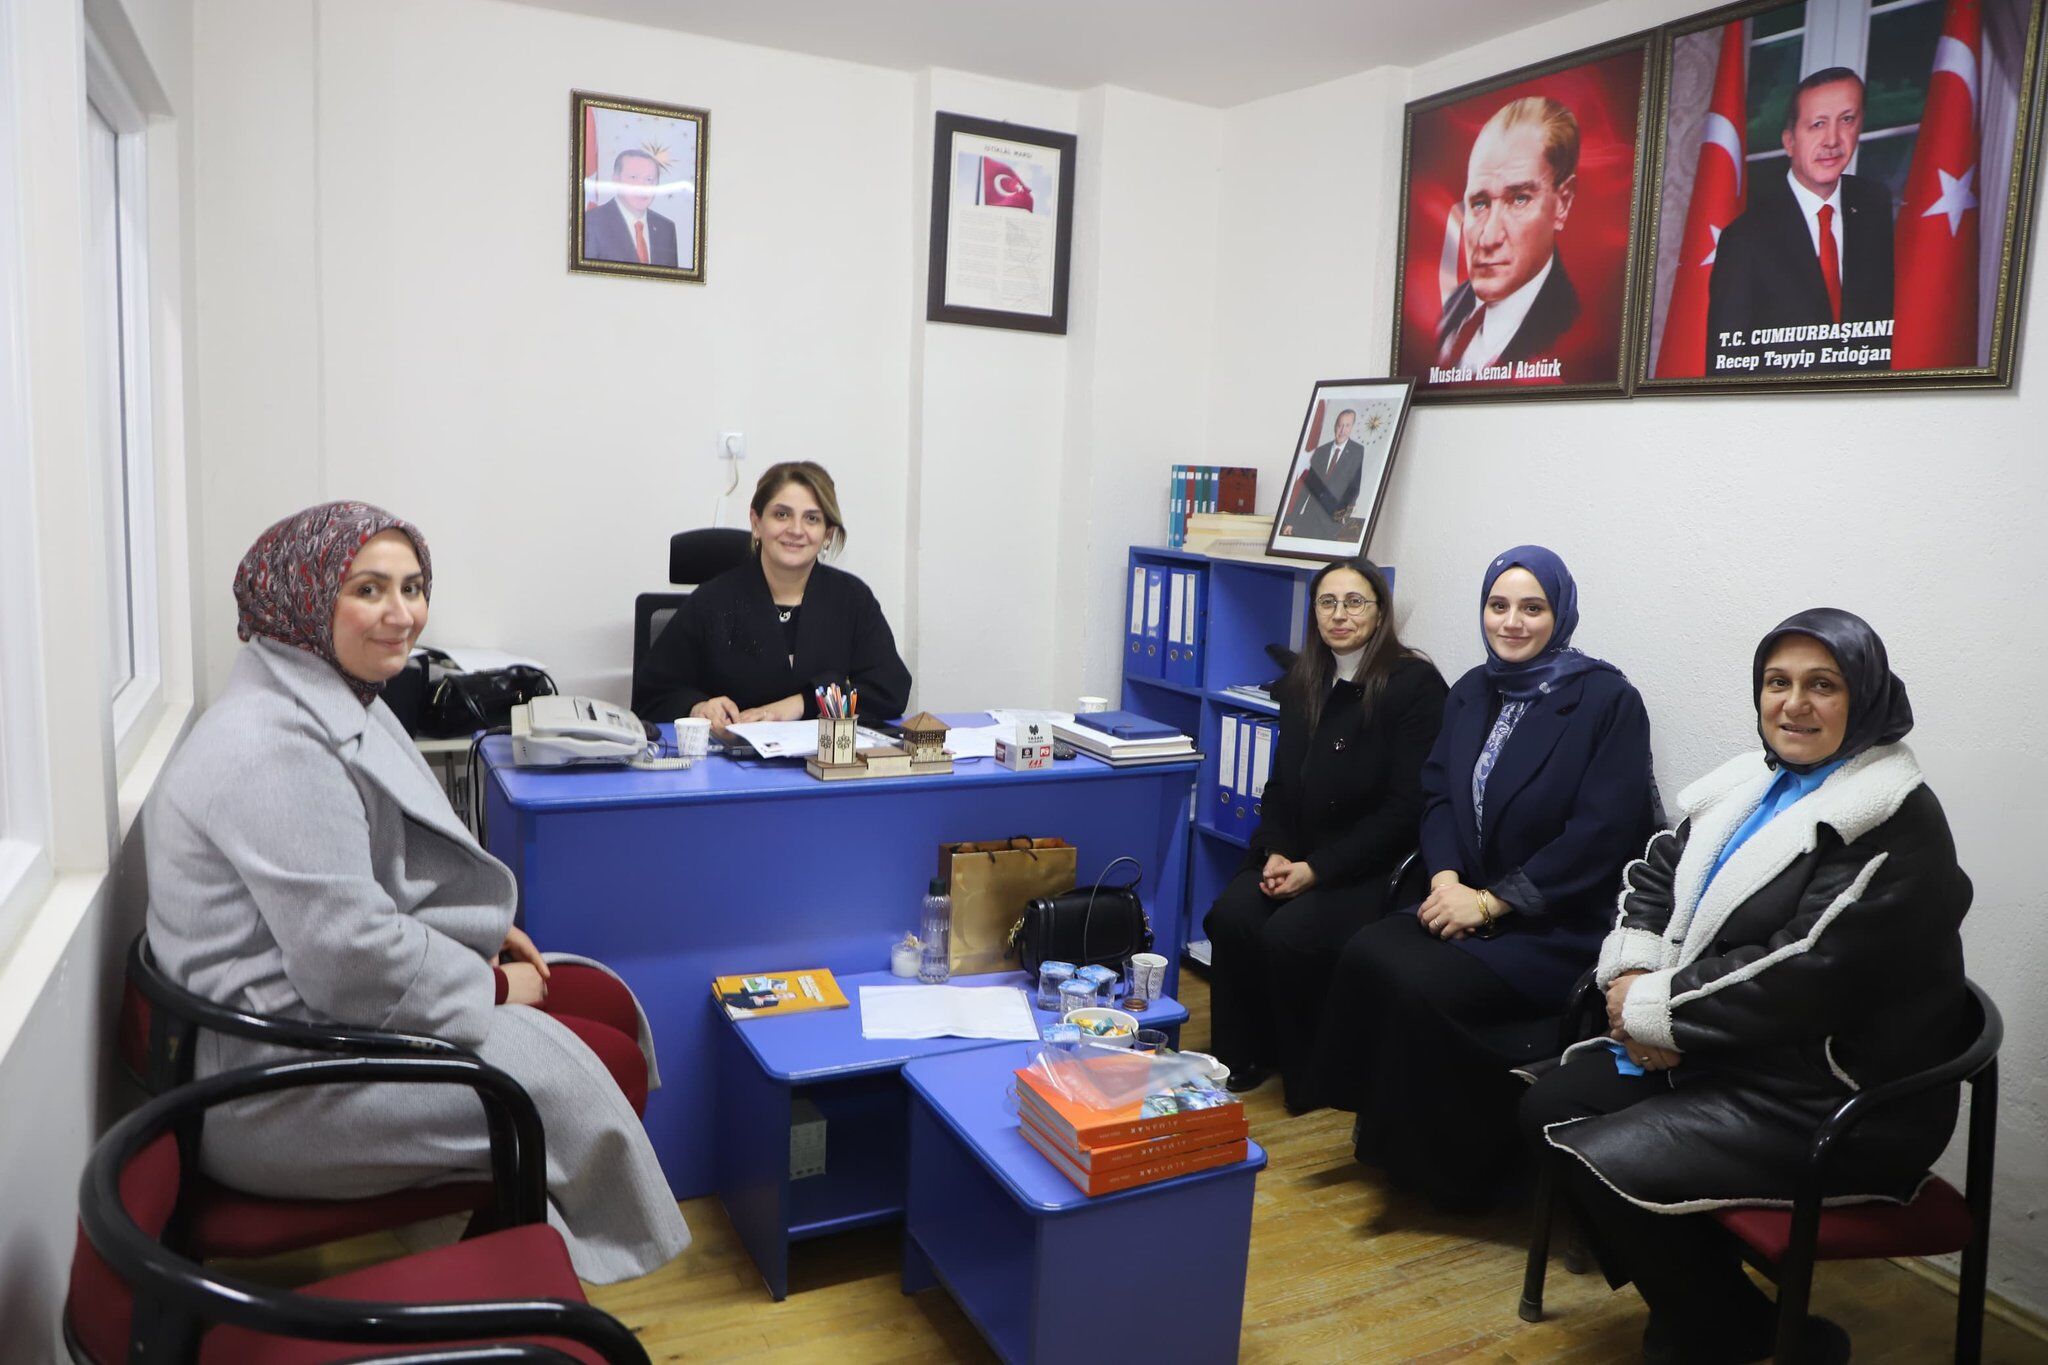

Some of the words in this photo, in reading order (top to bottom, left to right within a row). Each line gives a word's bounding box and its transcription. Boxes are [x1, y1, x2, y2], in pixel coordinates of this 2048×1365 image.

[1719, 332, 1746, 347] T.C.
[1751, 320, 1895, 344] CUMHURBAŞKANI
[1428, 366, 1473, 384] Mustafa
[1475, 361, 1513, 381] Kemal
[1515, 358, 1562, 379] Atatürk
[1715, 354, 1760, 371] Recep
[1764, 349, 1815, 369] Tayyip
[1820, 345, 1892, 366] Erdoğan
